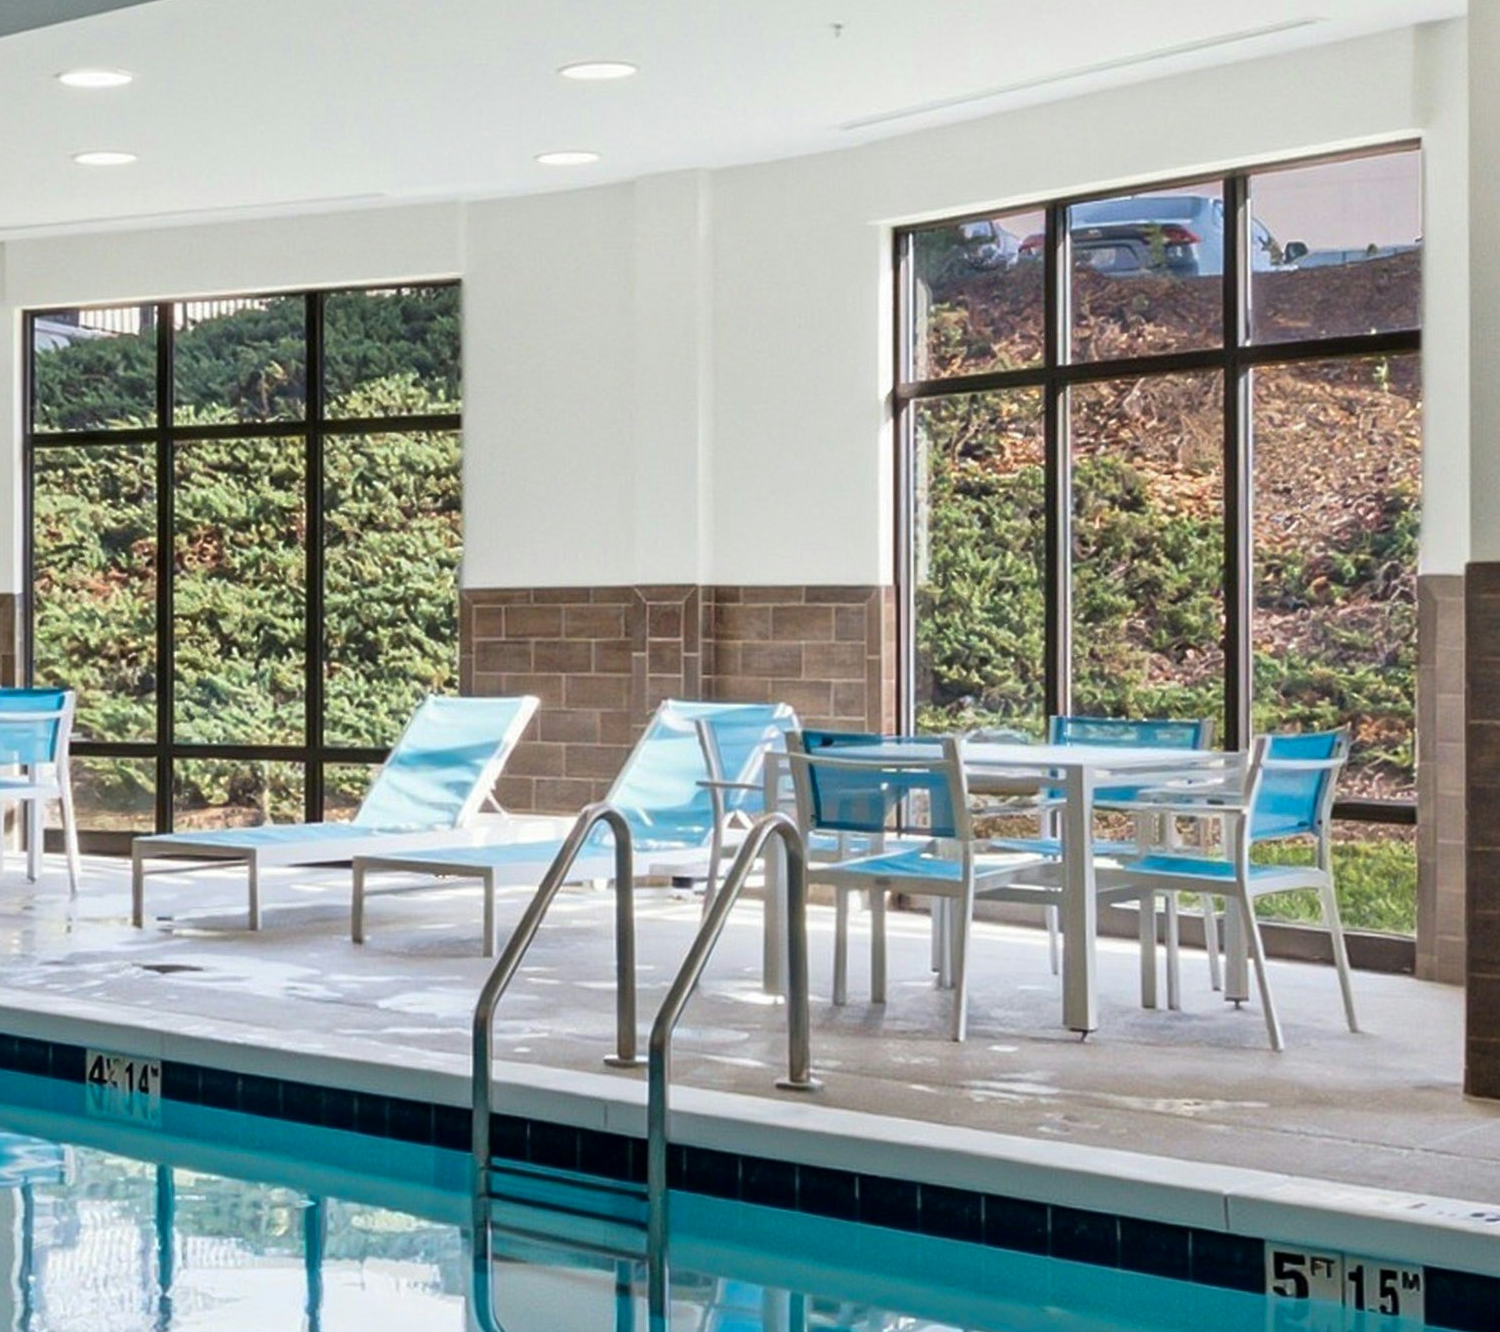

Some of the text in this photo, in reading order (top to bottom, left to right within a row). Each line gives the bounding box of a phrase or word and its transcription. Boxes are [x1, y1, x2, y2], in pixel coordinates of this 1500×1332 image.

[1273, 1251, 1309, 1299] 5
[1310, 1256, 1335, 1278] FT
[1402, 1271, 1421, 1291] M
